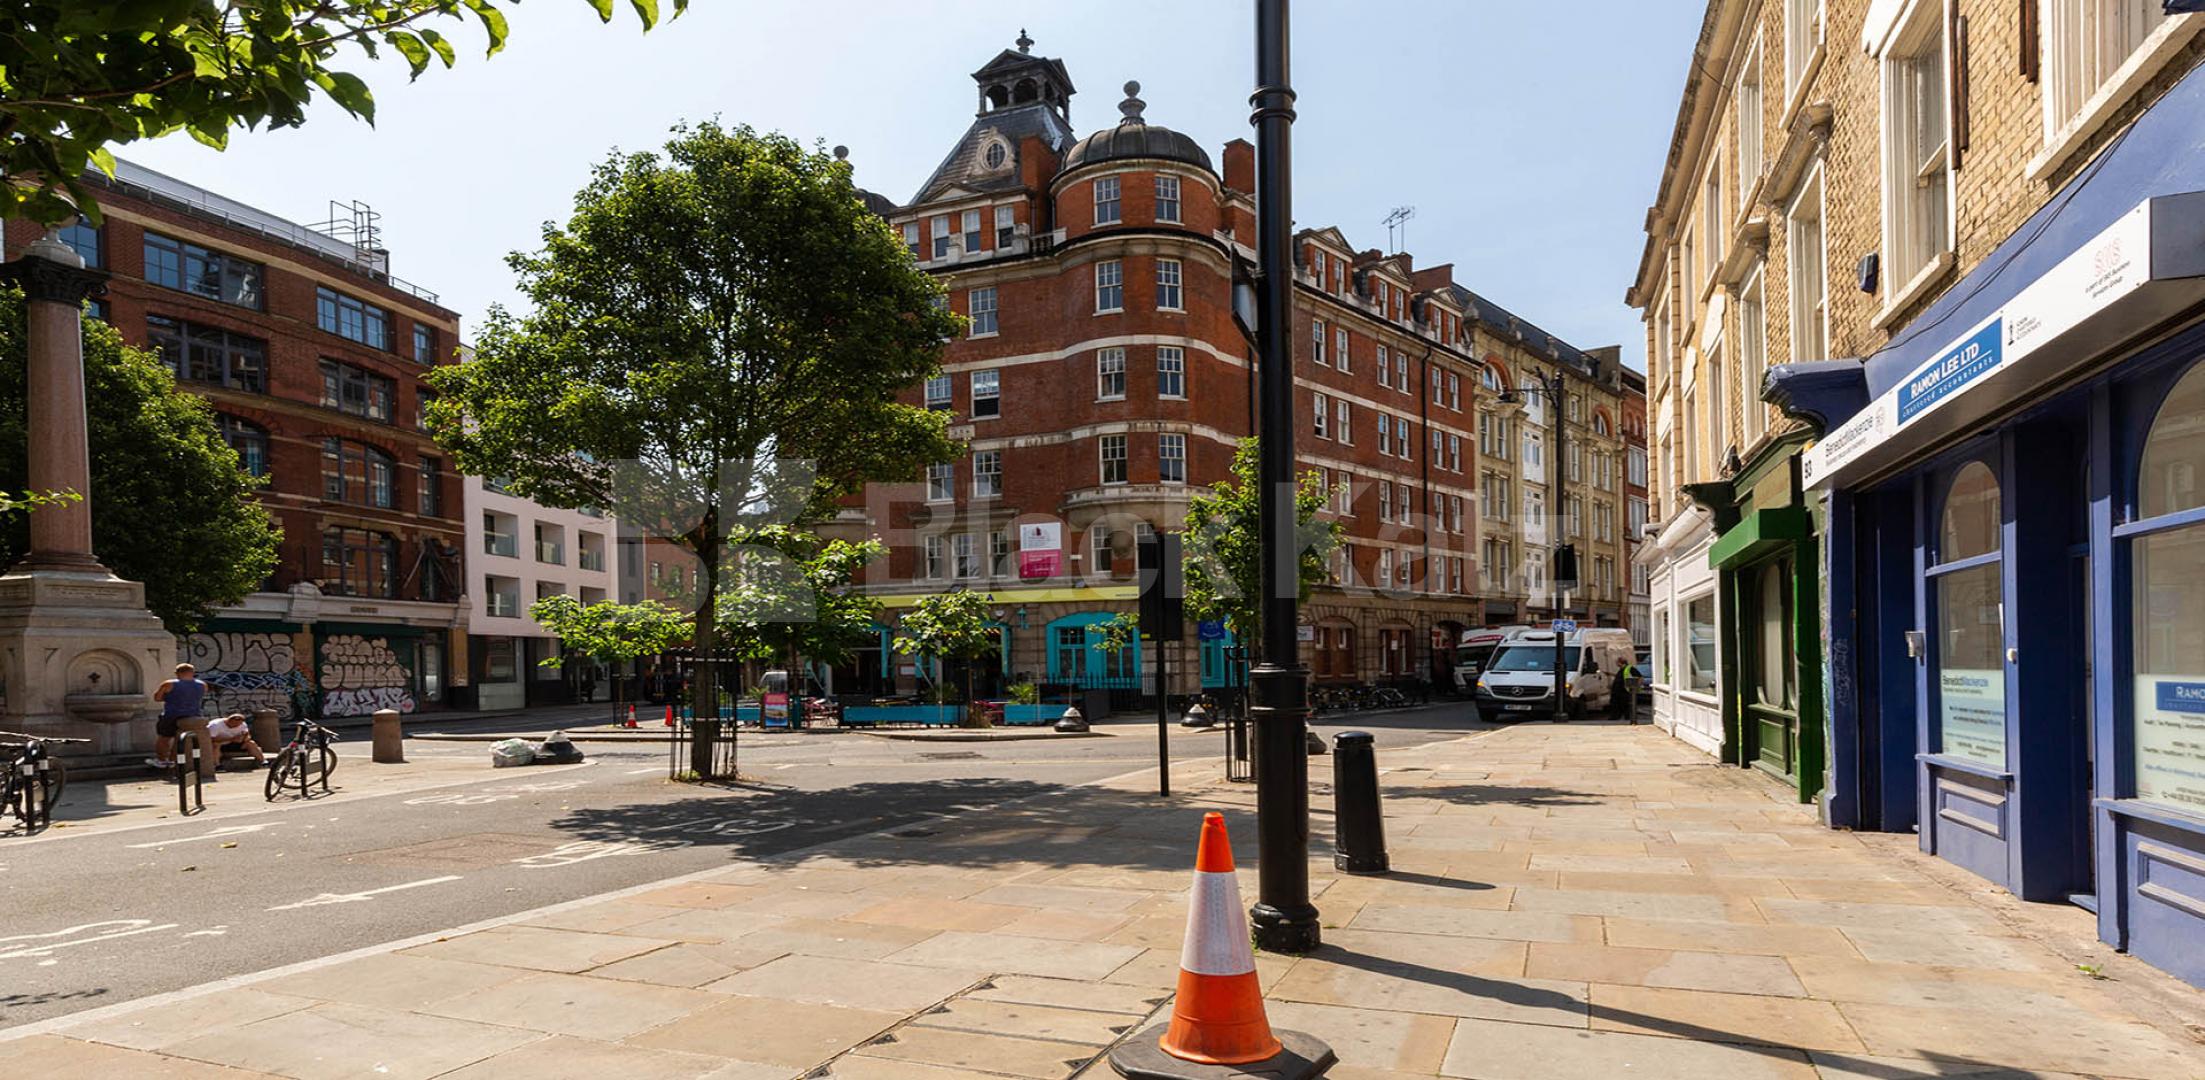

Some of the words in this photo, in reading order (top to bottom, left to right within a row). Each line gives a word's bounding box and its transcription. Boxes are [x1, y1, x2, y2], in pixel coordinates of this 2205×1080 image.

[1911, 367, 1941, 399] RAMON
[1941, 355, 1960, 378] LEE
[1960, 342, 1980, 366] LTD
